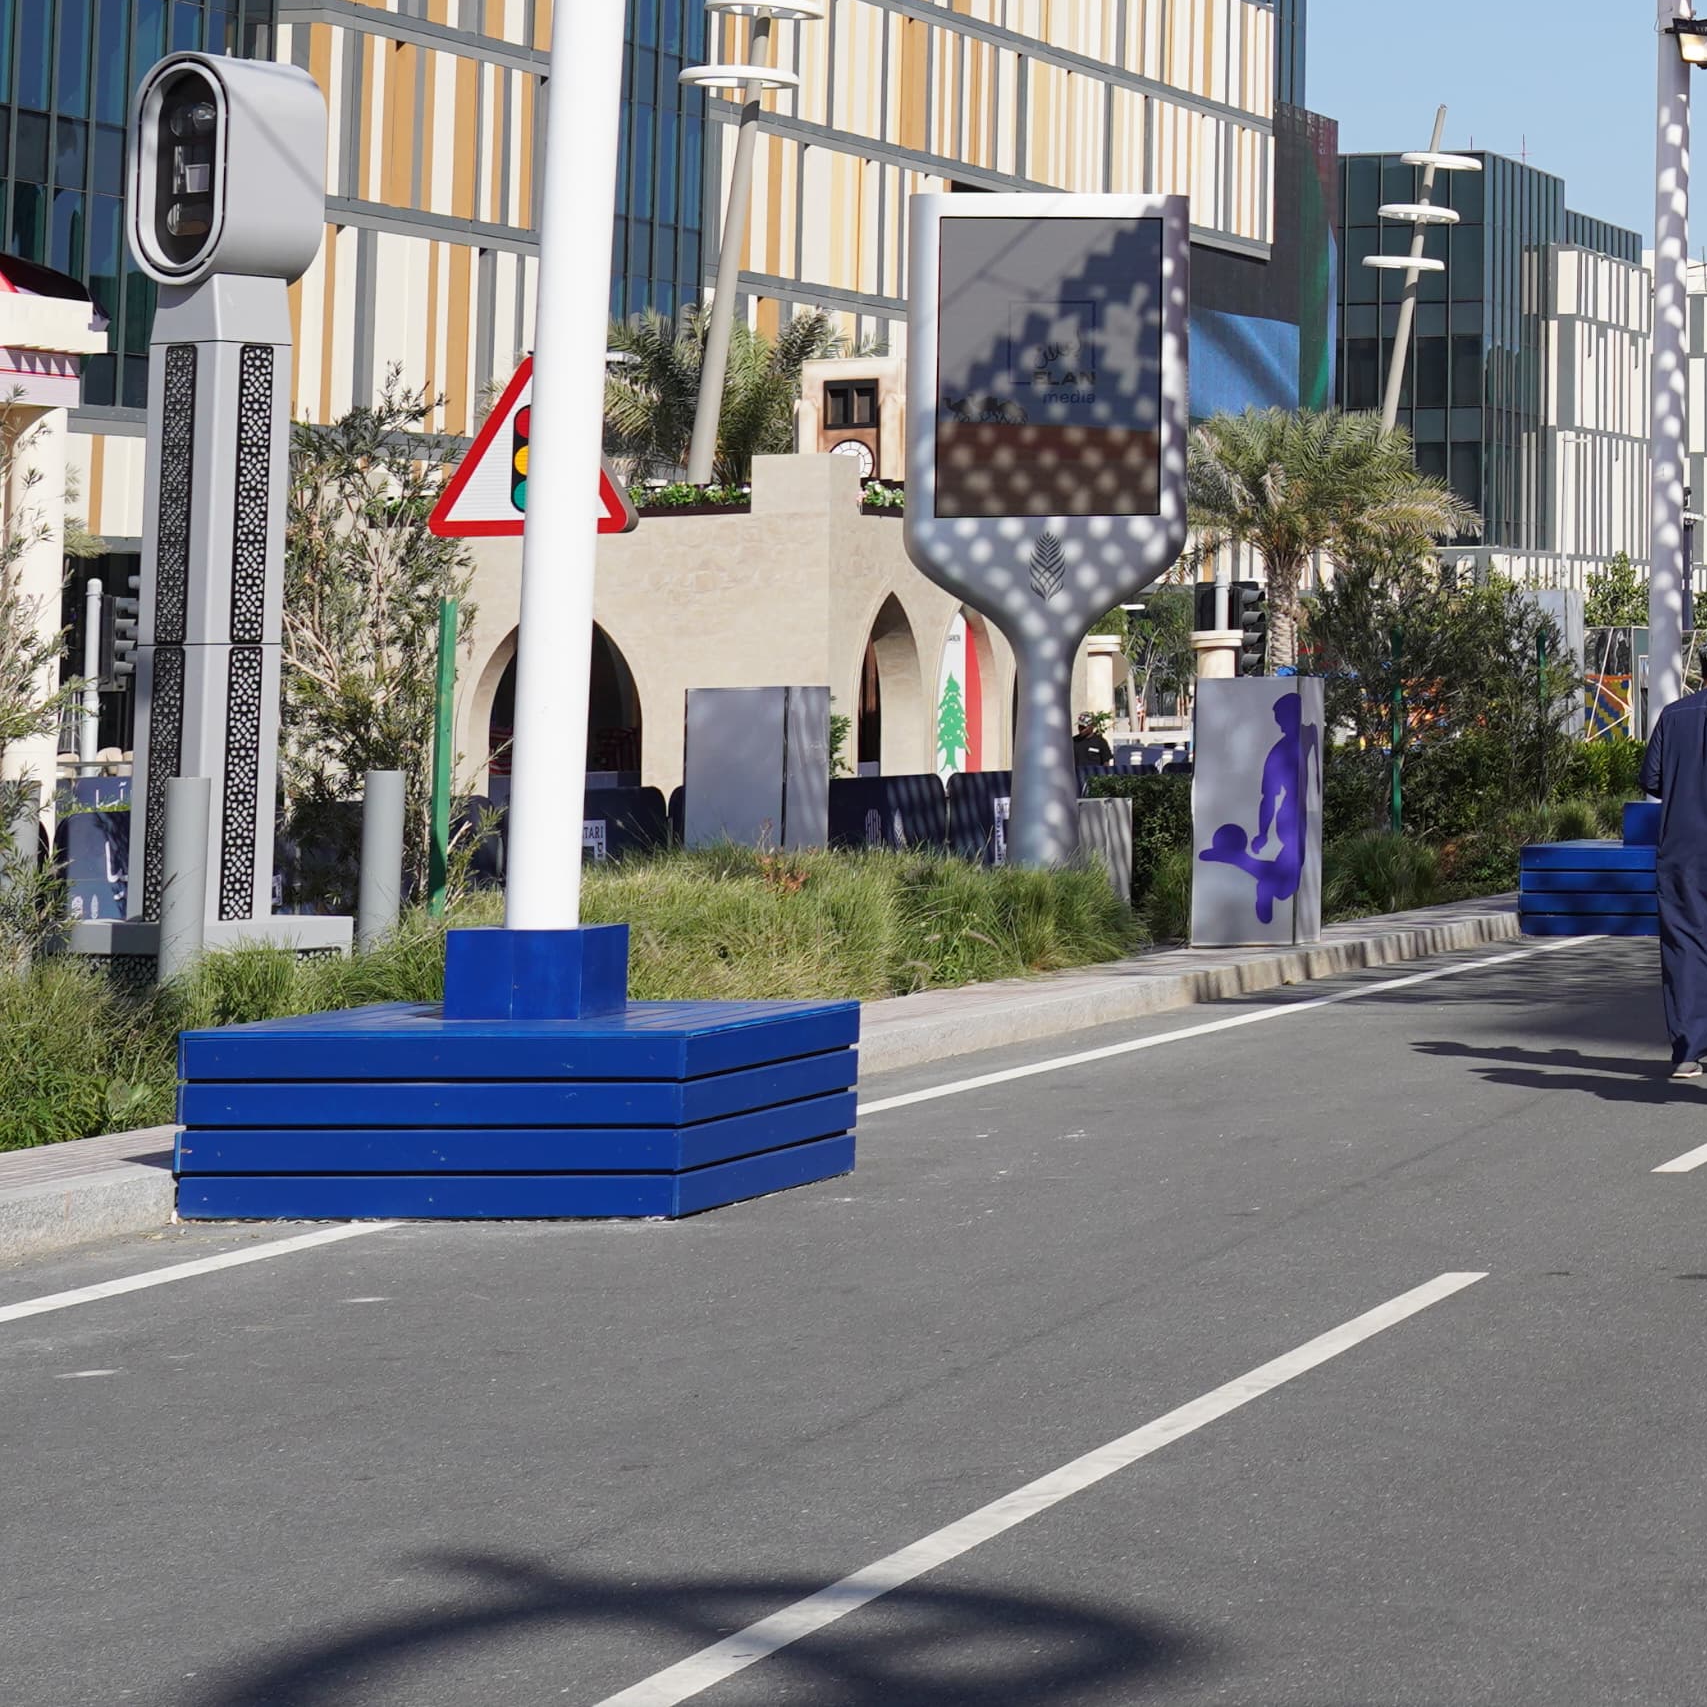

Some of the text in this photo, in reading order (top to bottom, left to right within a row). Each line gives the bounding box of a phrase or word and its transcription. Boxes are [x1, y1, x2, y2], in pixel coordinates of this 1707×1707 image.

[1033, 371, 1097, 386] ELAN
[1042, 390, 1096, 404] media
[582, 826, 604, 839] TARI
